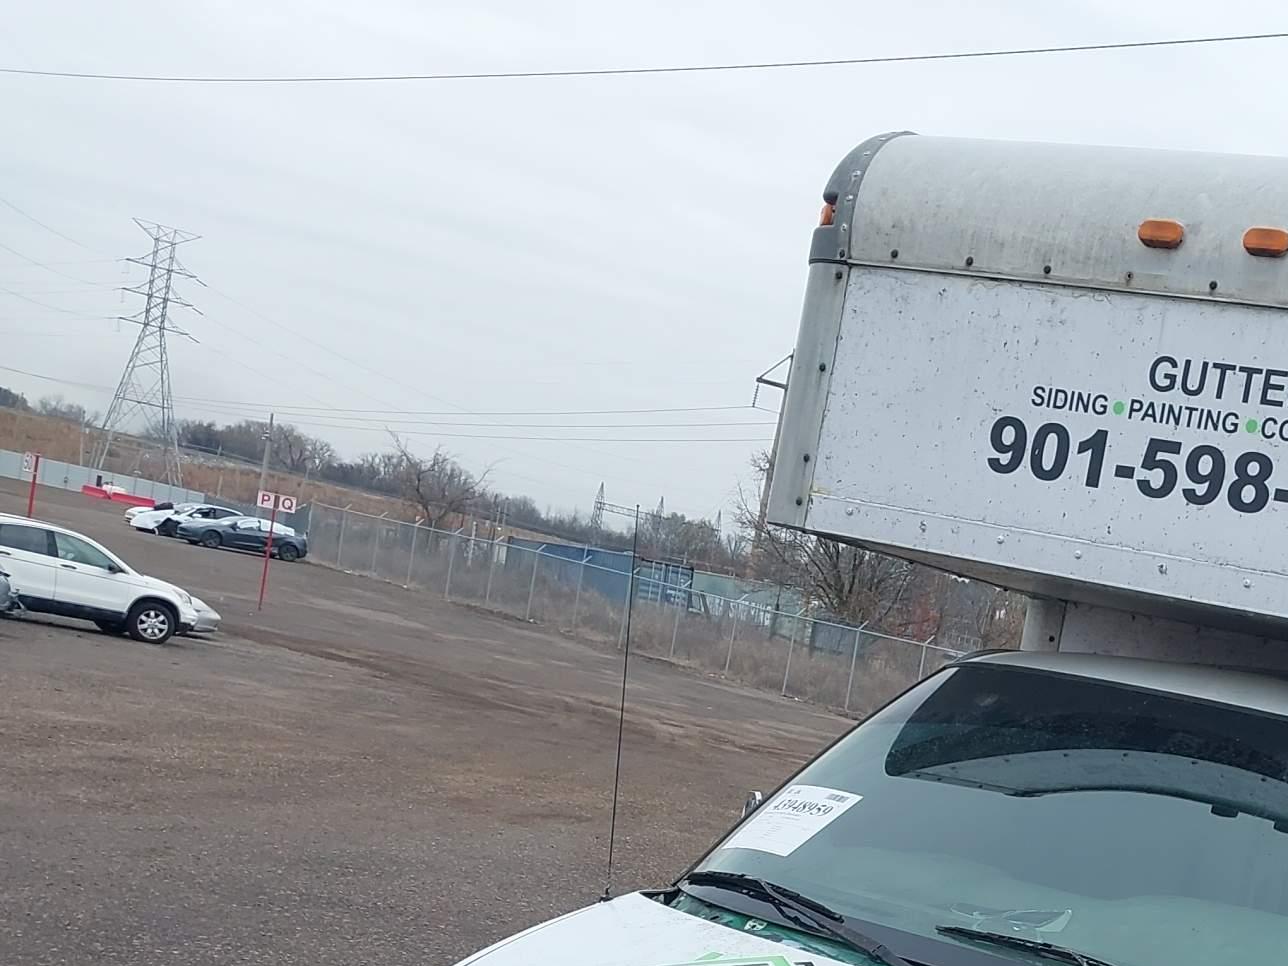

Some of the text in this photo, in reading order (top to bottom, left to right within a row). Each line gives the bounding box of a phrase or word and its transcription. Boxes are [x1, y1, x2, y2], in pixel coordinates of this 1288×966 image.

[1031, 385, 1109, 416] SIDING
[1128, 399, 1239, 434] PAINTING
[262, 495, 293, 510] P Q
